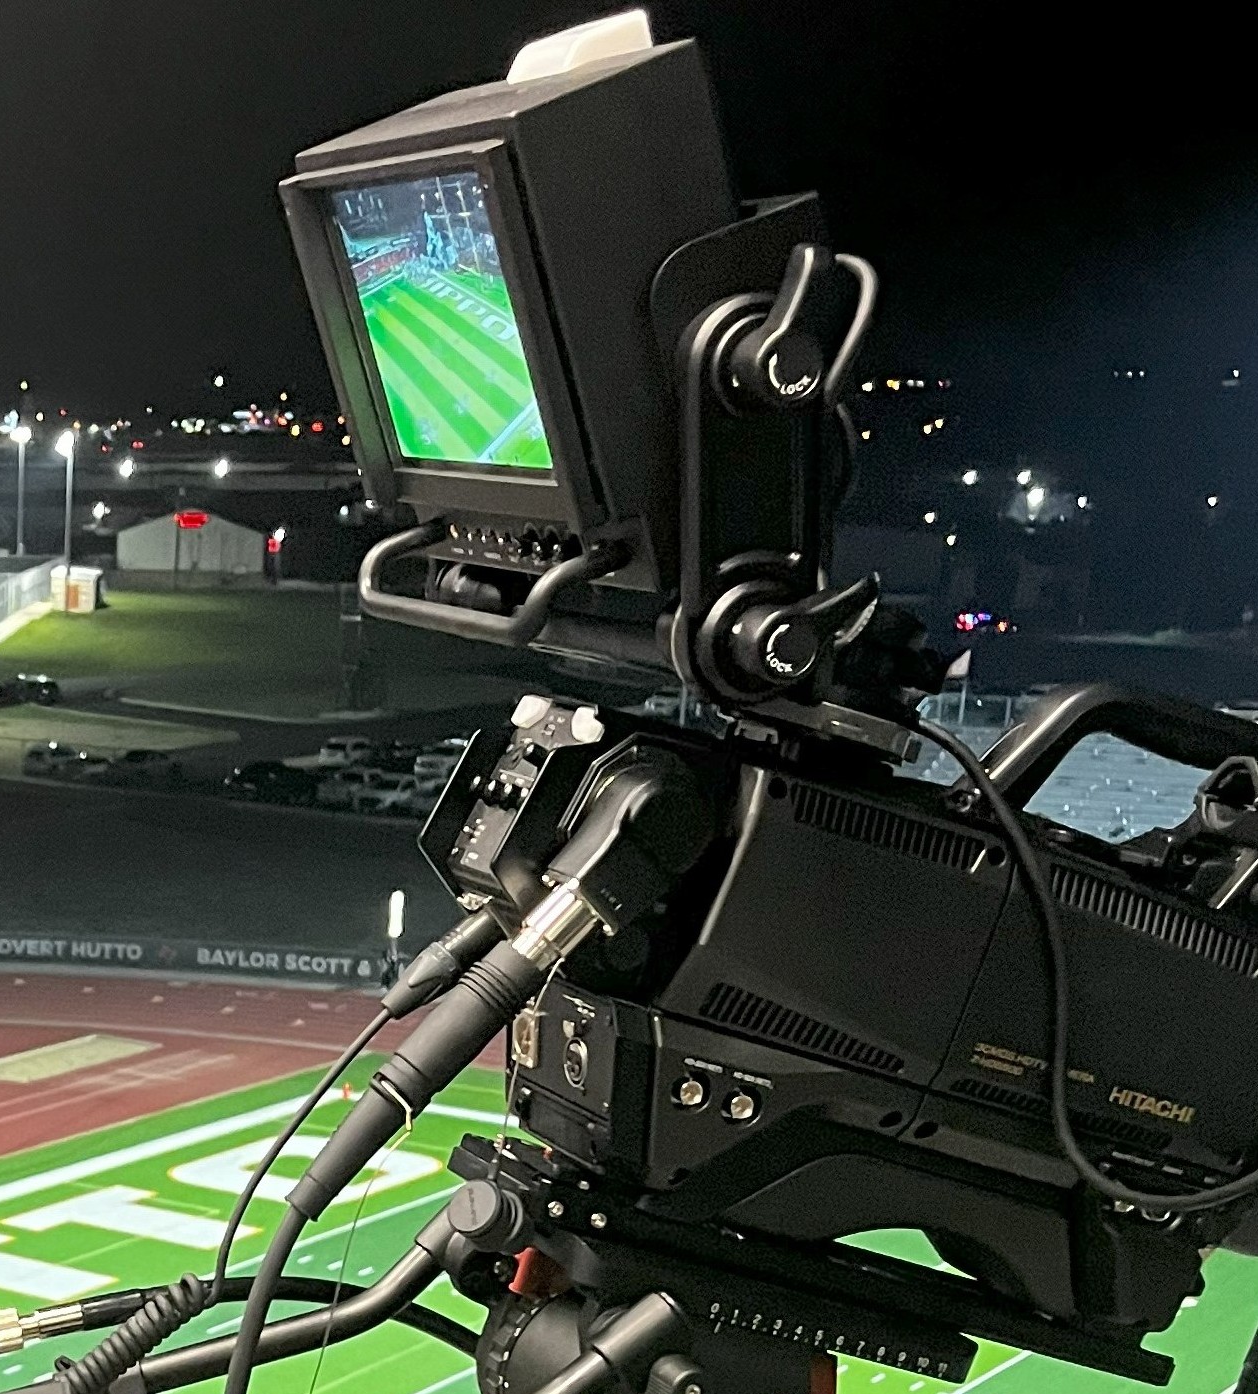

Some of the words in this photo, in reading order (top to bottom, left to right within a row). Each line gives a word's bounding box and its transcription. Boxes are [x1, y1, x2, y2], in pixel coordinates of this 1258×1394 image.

[780, 374, 812, 395] LOCK
[766, 652, 793, 673] LOCK
[70, 940, 143, 961] HUTTO
[196, 947, 280, 970] BAYLOR
[284, 953, 353, 976] SCOTT
[1108, 1086, 1196, 1123] HITACHI
